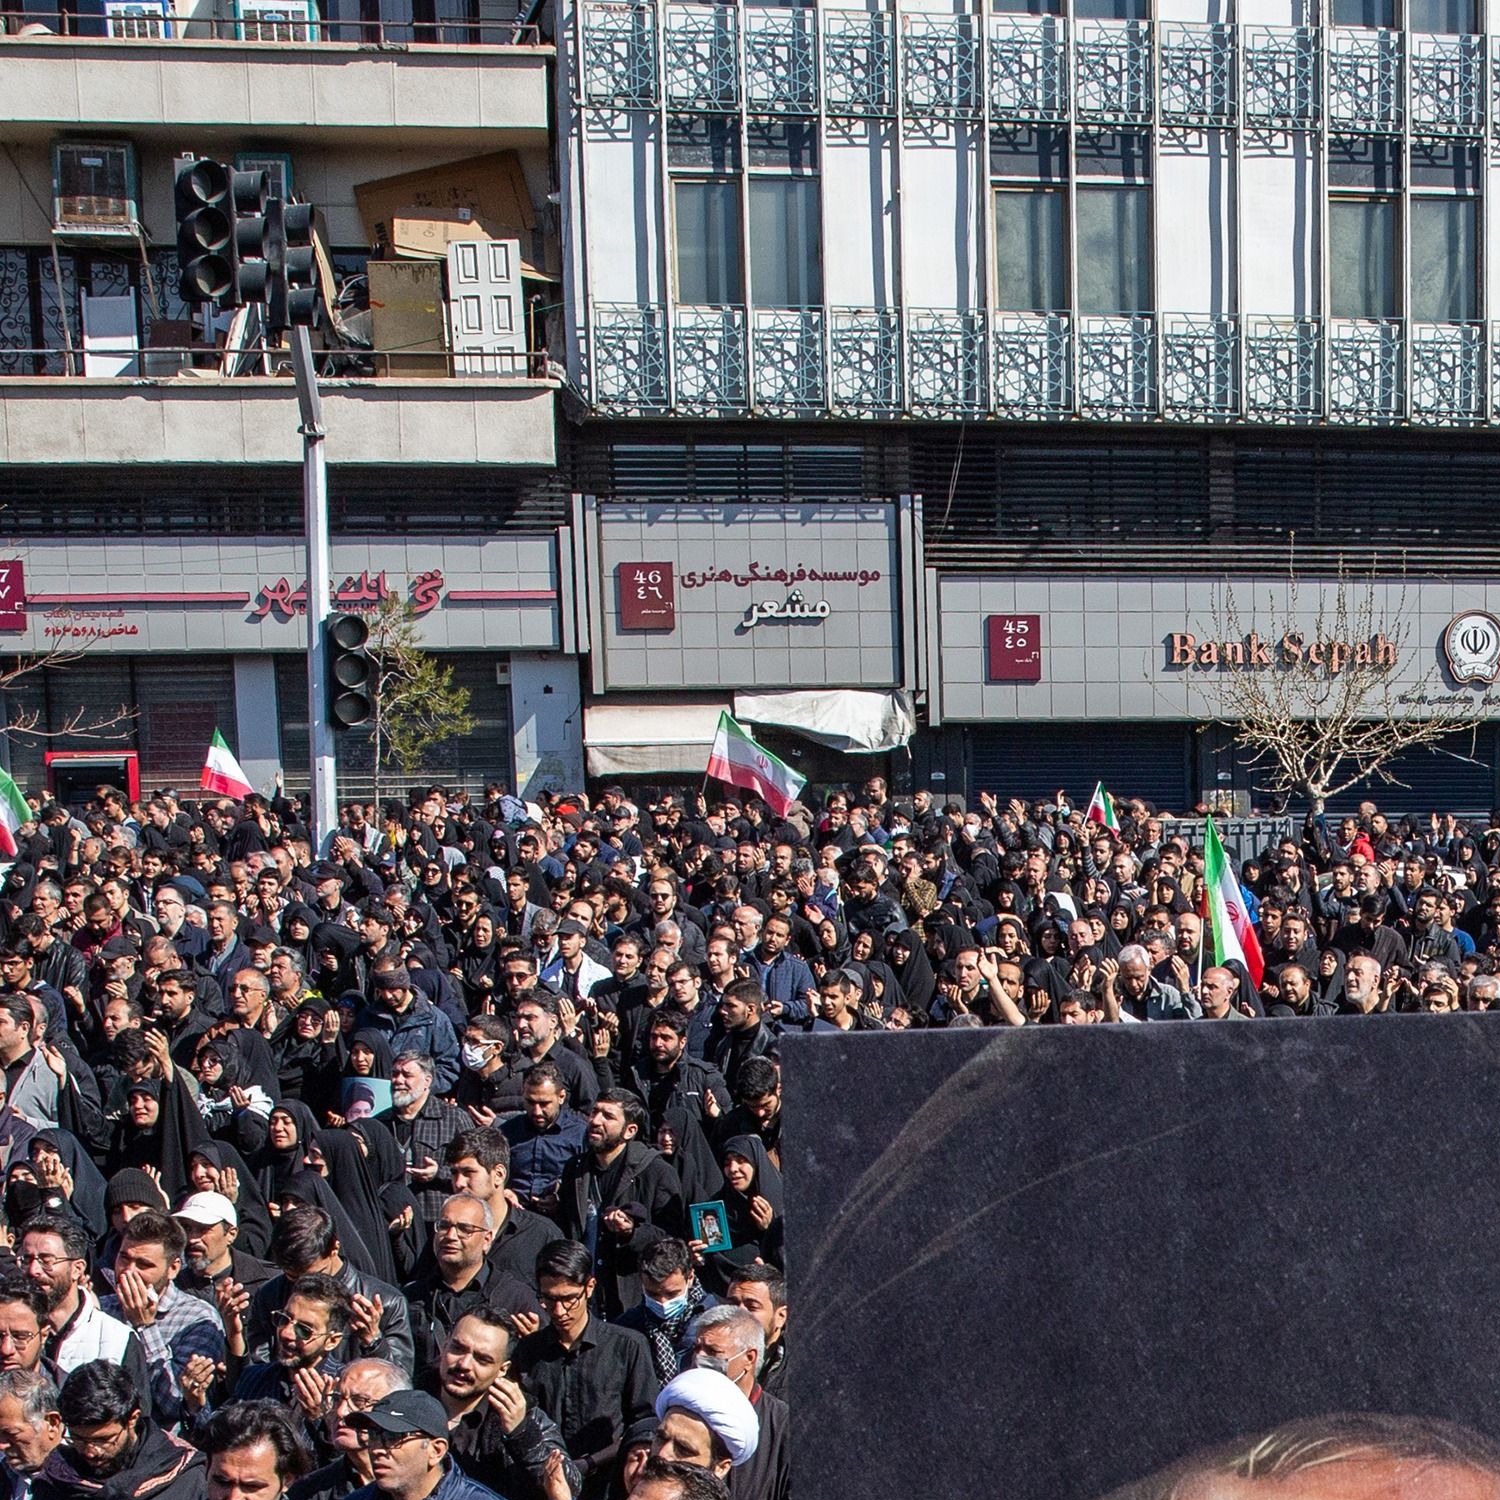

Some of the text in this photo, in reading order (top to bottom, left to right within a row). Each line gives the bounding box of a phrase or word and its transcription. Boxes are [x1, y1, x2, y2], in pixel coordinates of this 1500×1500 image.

[338, 569, 399, 601] انک
[633, 570, 662, 584] 46
[680, 561, 881, 588] موسسه فرهنگی هنری
[743, 589, 831, 627] مشعر
[1003, 619, 1029, 634] 45
[1170, 632, 1398, 673] Bank Sepah
